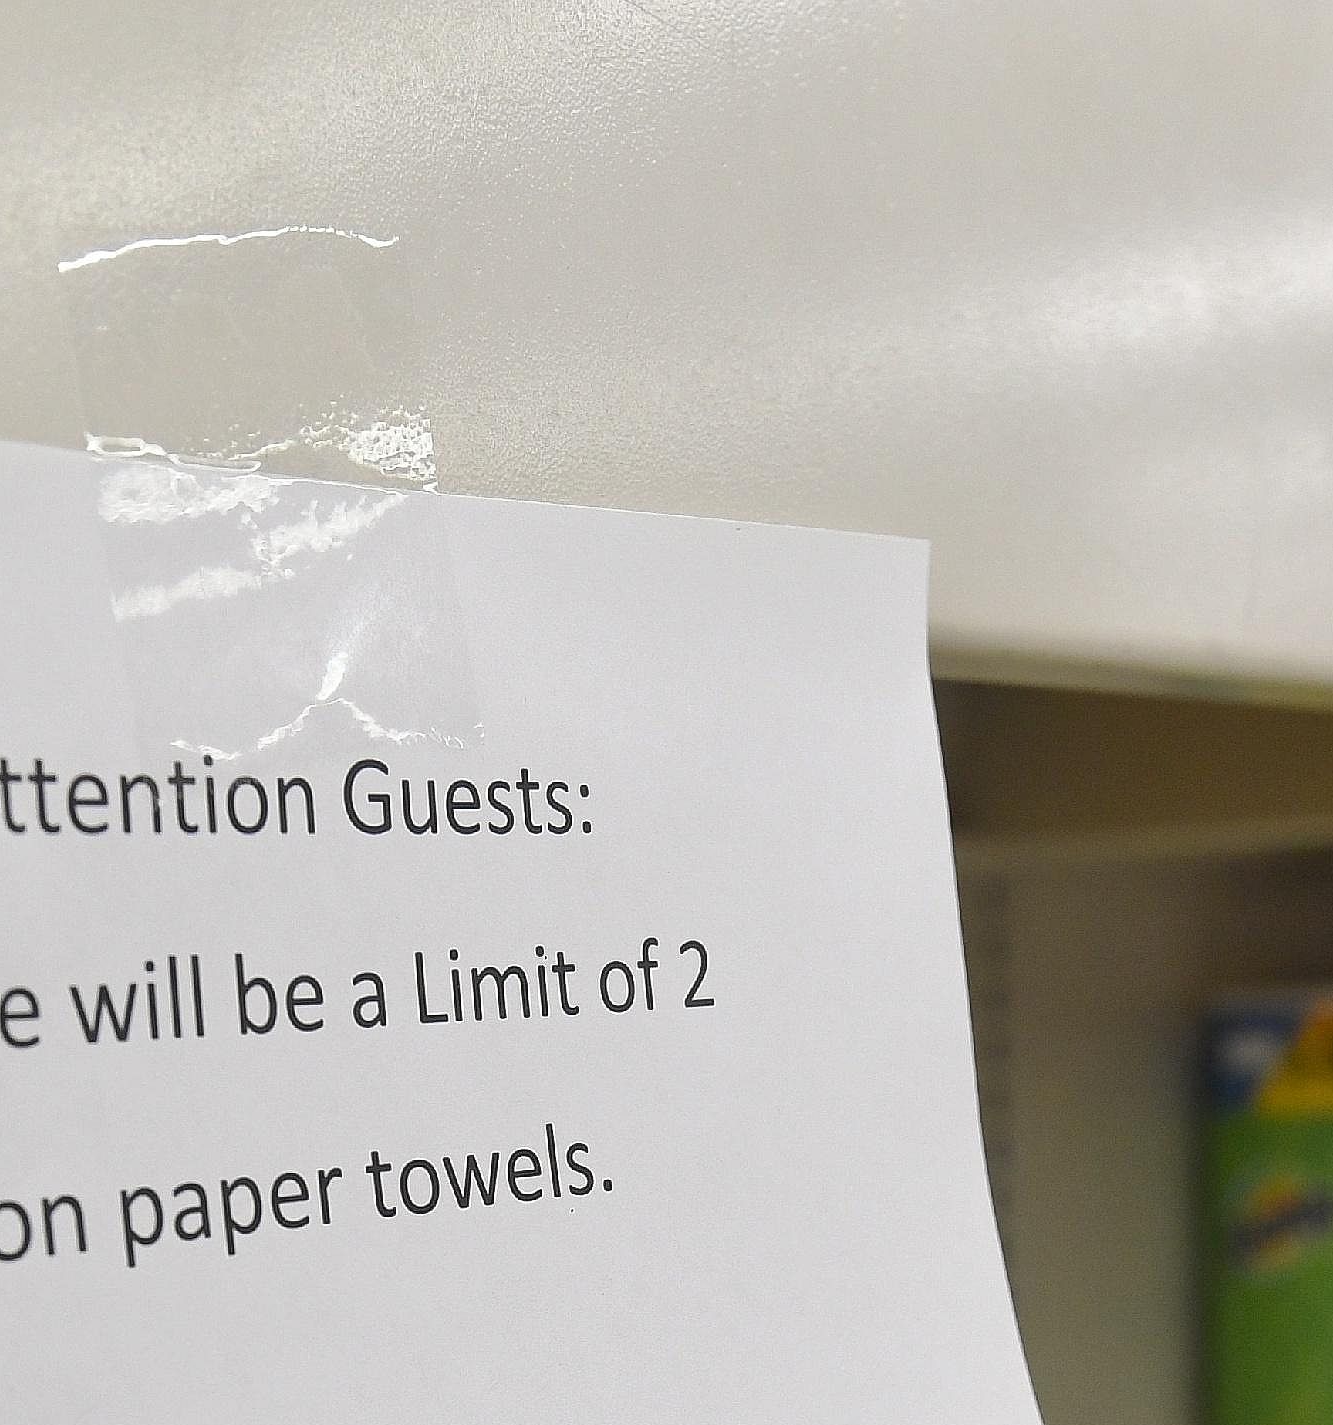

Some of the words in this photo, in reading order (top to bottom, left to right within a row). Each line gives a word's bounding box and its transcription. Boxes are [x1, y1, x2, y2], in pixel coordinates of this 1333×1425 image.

[342, 757, 593, 837] Guests:
[68, 952, 206, 1045] will
[233, 952, 325, 1037] be
[351, 971, 388, 1030] a
[413, 944, 581, 1025] Limit
[598, 936, 660, 1015] of
[678, 939, 716, 1010] 2
[118, 1166, 344, 1270] paper
[364, 1121, 614, 1219] towels.
